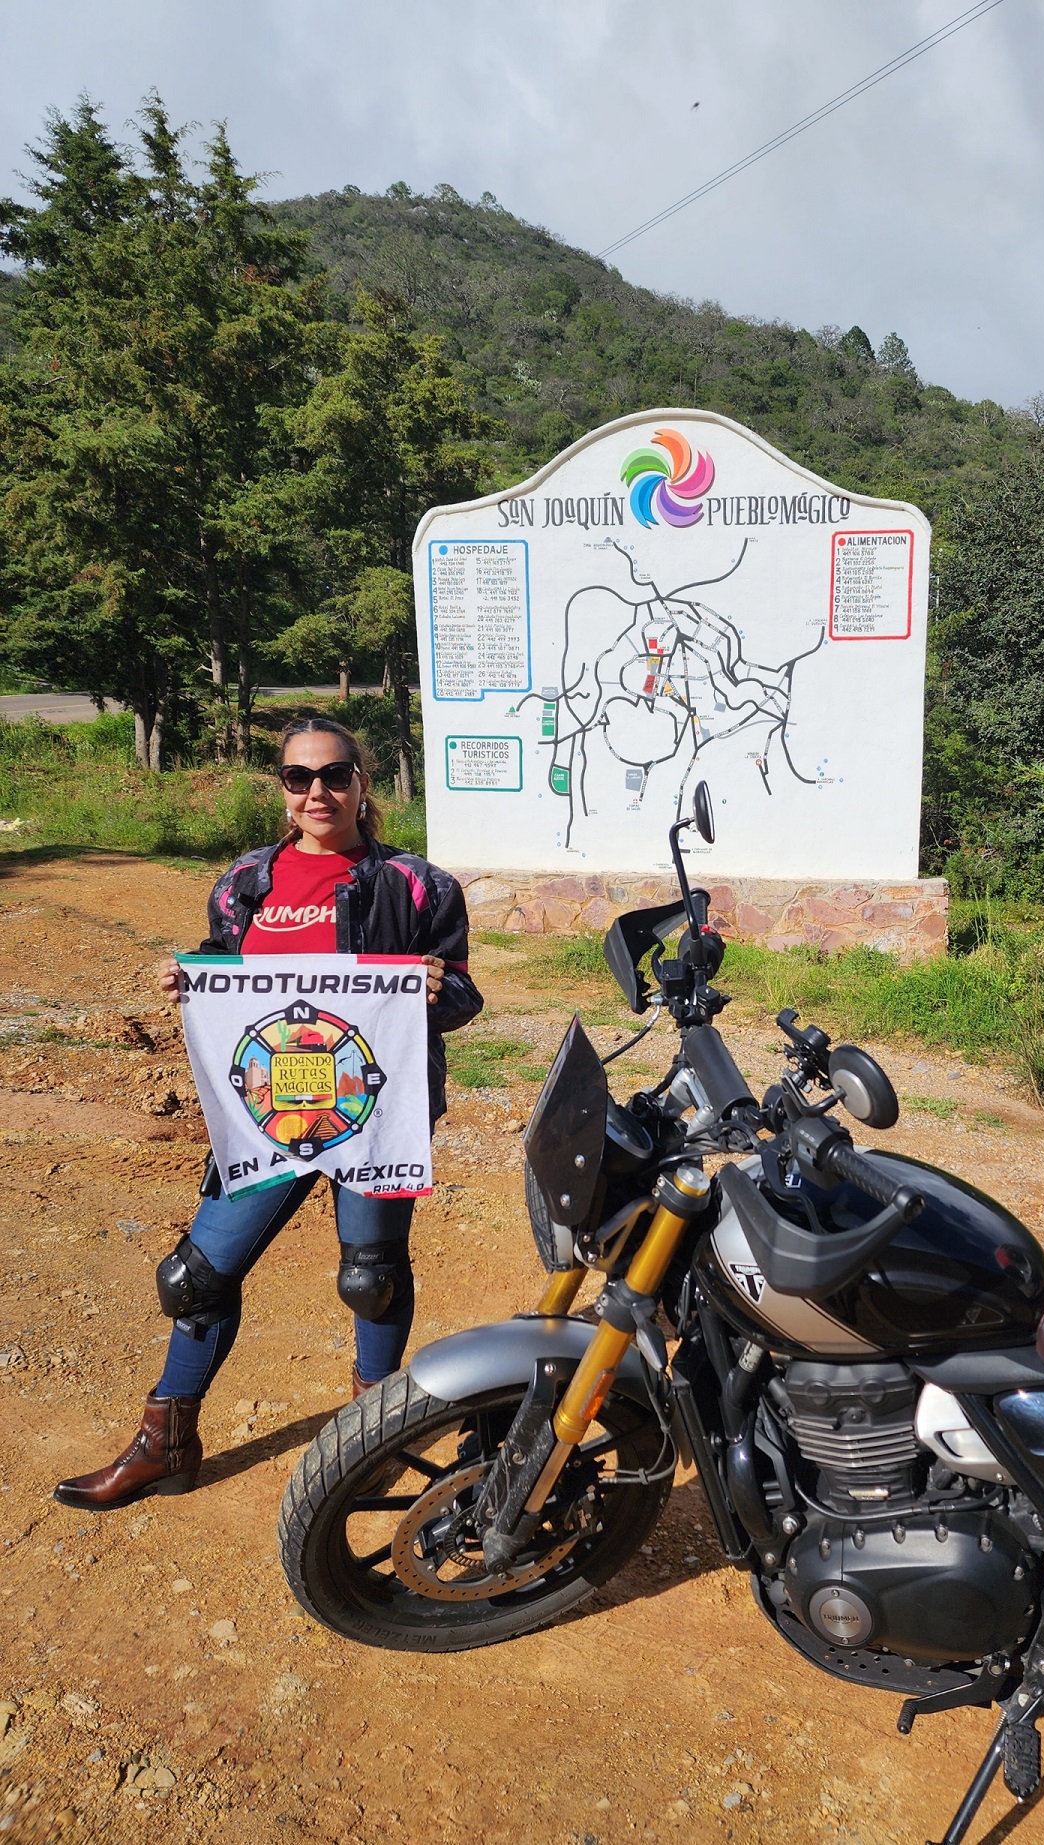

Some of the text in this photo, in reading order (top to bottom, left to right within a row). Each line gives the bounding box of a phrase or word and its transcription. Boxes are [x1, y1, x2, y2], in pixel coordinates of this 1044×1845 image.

[847, 536, 906, 546] ALIMENTACION
[453, 545, 508, 554] HOSPEDAJE
[461, 741, 509, 750] RECORRIDOS
[463, 751, 509, 759] TURISTICOS
[294, 1006, 310, 1019] N
[368, 1073, 381, 1085] E
[299, 1143, 314, 1155] S
[228, 1157, 259, 1181] EN
[334, 1161, 424, 1183] MÉXICO
[823, 1614, 859, 1623] TRIUMPH
